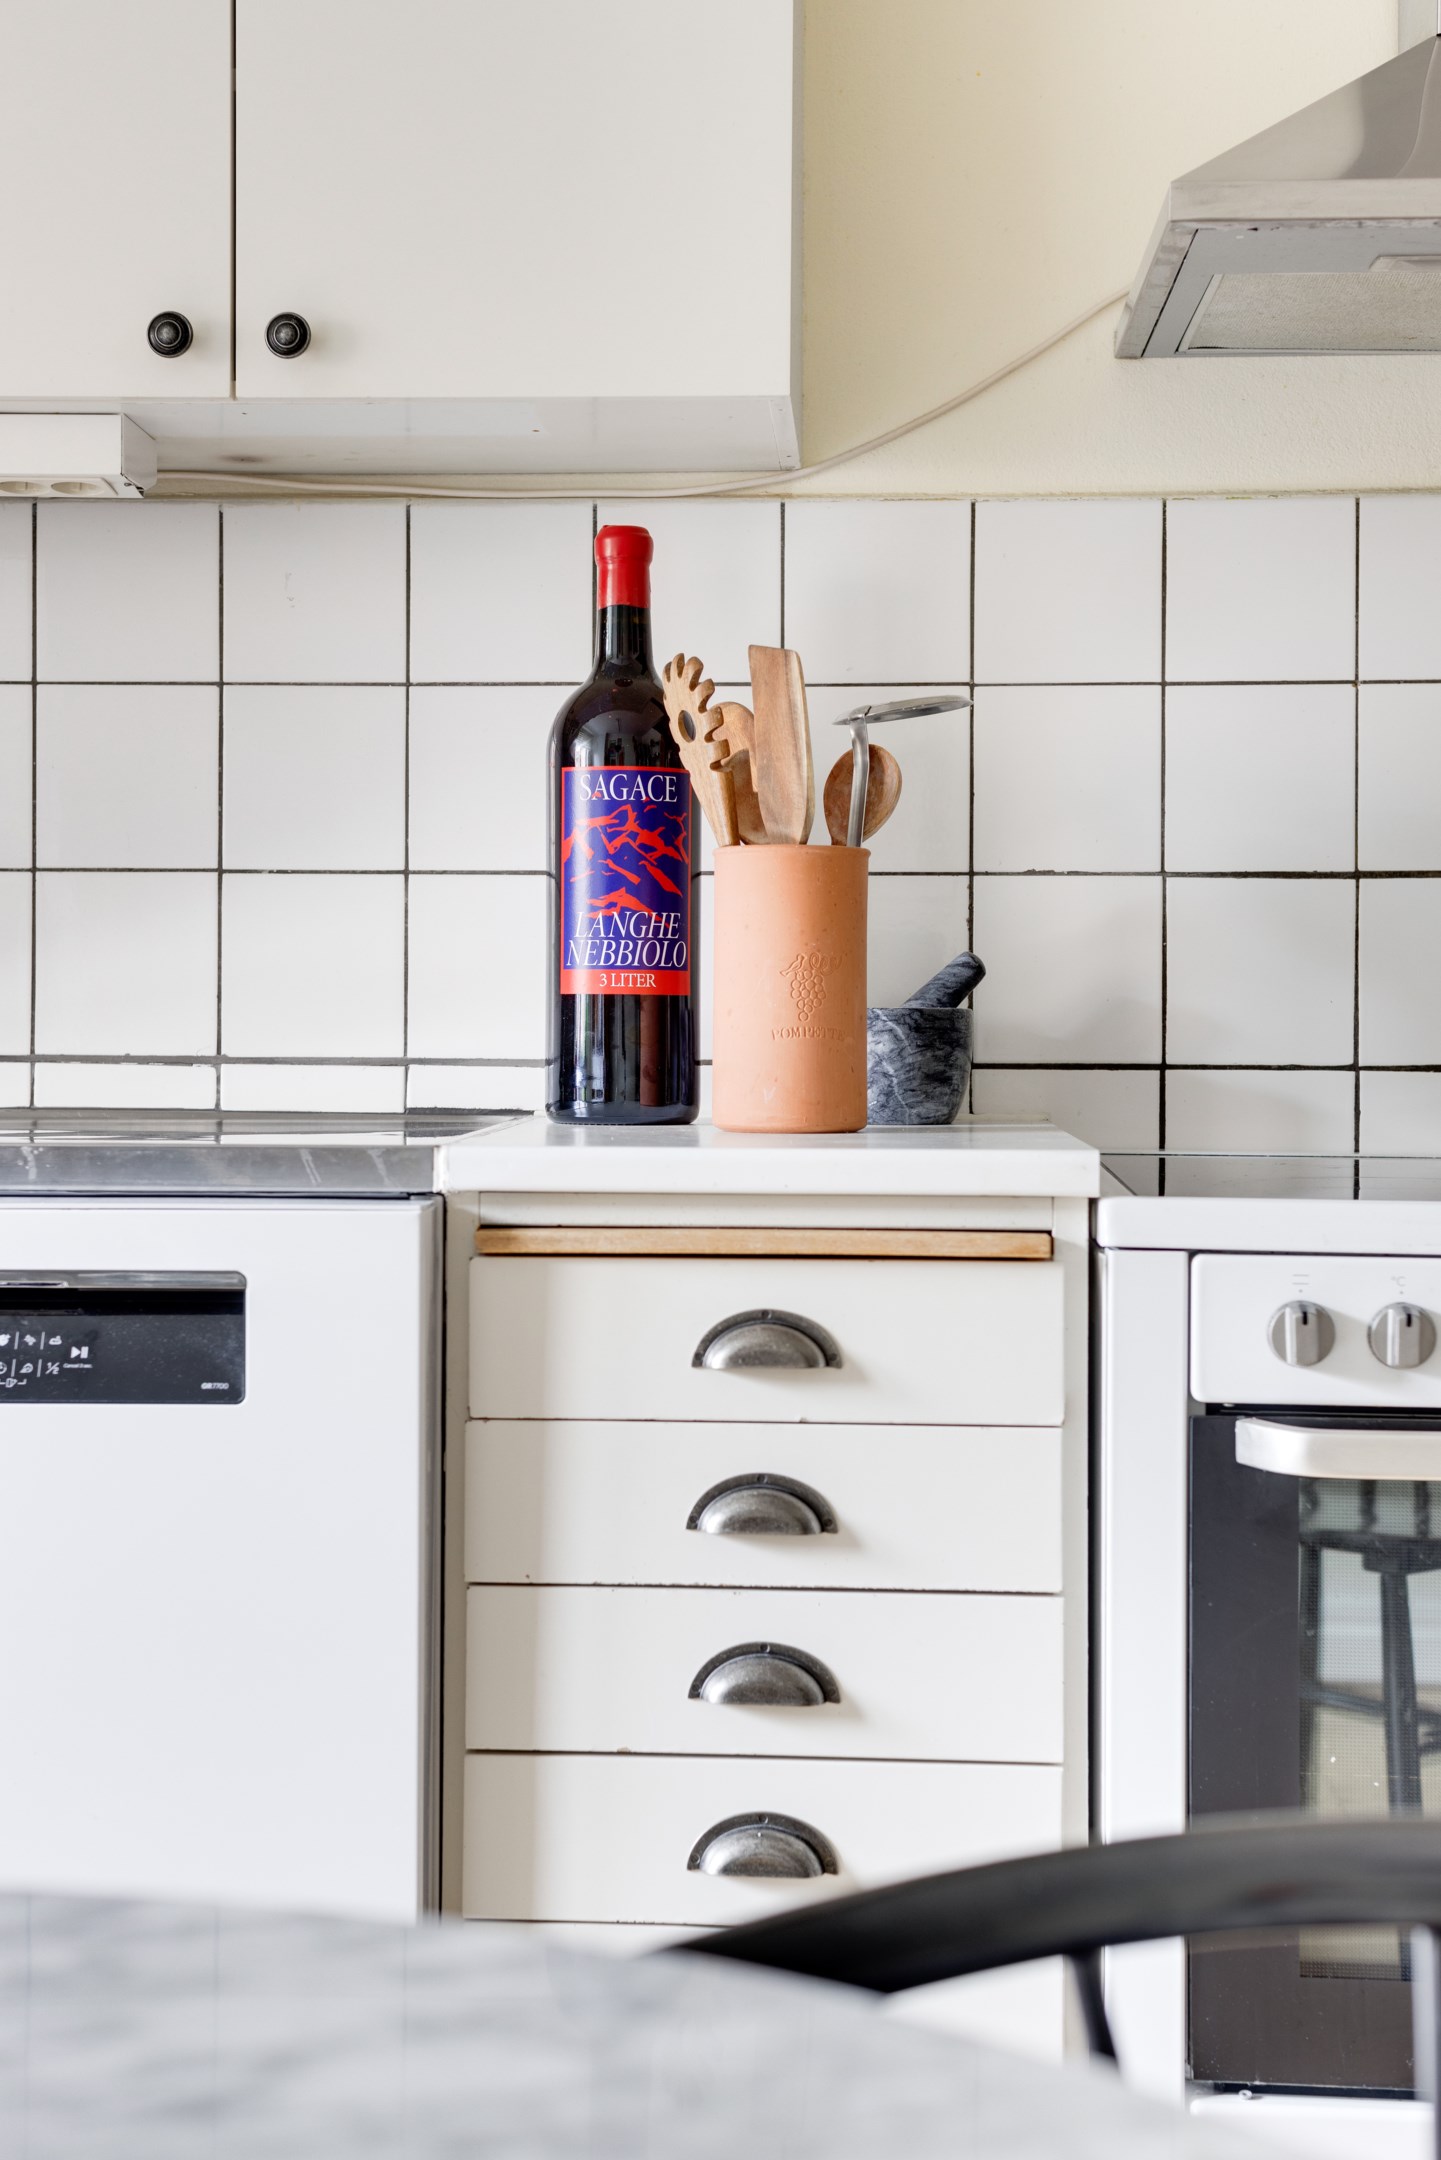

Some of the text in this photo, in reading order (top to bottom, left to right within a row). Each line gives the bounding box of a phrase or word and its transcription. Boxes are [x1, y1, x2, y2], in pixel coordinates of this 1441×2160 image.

[579, 773, 678, 803] SAGACE
[574, 911, 681, 940] LANGHE
[566, 939, 687, 968] NEBBIOLO
[599, 973, 657, 988] 3 LITER
